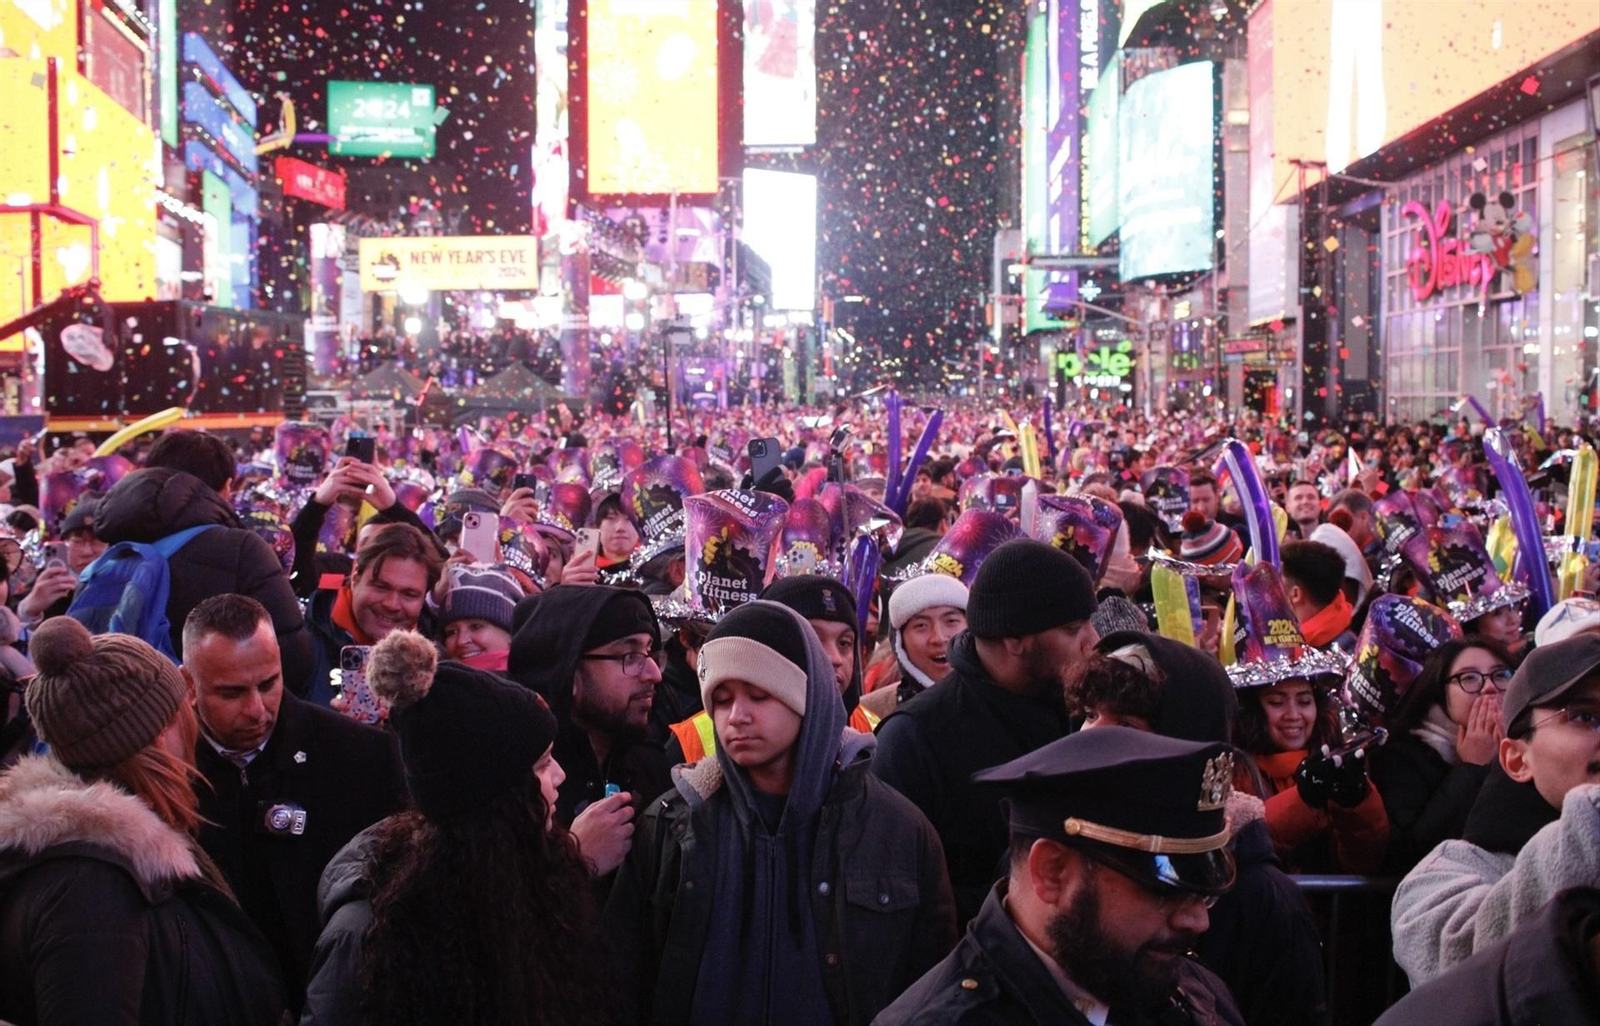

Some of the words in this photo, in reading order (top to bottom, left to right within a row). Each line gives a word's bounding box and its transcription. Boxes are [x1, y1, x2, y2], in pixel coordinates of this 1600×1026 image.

[352, 98, 411, 119] 2024
[410, 250, 442, 265] NEW
[448, 249, 497, 264] YEAR'S
[501, 249, 527, 264] EVE
[1401, 199, 1495, 308] Disney
[498, 266, 527, 278] 2024
[642, 502, 675, 536] planet
[698, 570, 748, 590] planet
[1436, 562, 1472, 590] planet
[1444, 567, 1485, 593] fitness
[702, 583, 758, 602] fitness
[1267, 618, 1298, 635] 2024
[1394, 610, 1440, 649] fitness
